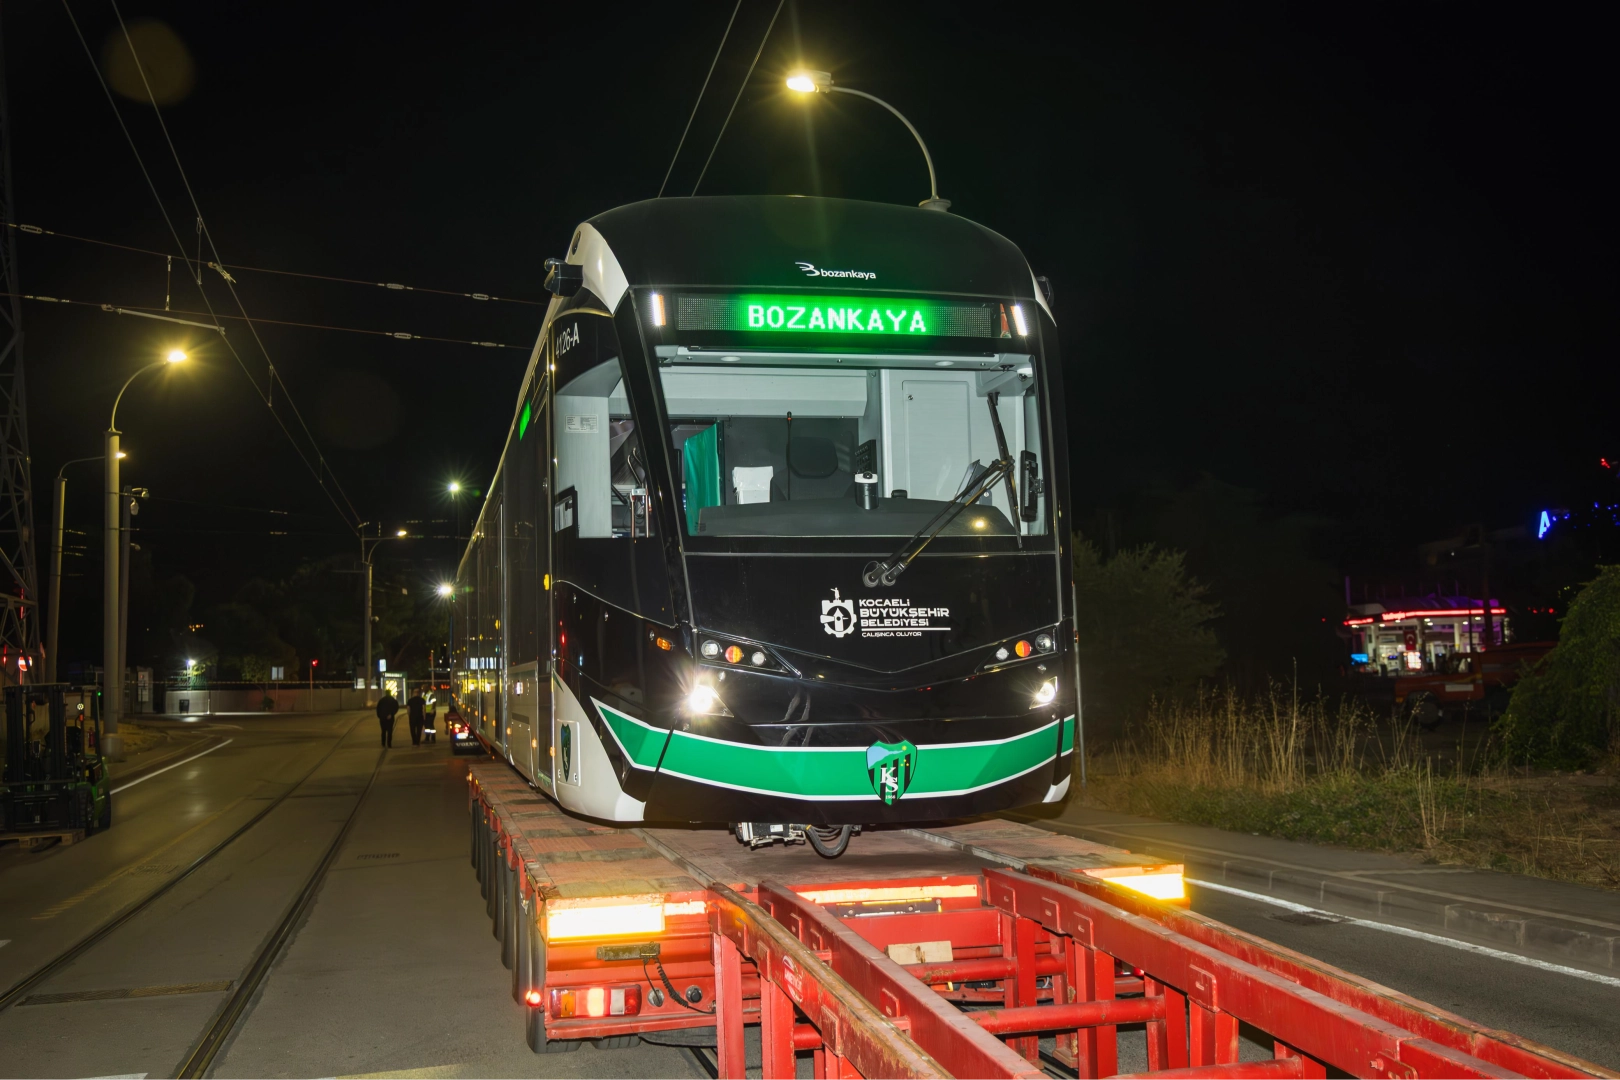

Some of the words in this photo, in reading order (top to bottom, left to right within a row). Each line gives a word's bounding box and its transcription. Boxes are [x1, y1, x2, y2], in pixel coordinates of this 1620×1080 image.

[820, 268, 877, 281] bozankaya
[748, 304, 926, 332] BOZANKAYA
[859, 598, 910, 607] KOCAELİ
[859, 607, 950, 619] BÜYÜKŞEHİR
[860, 618, 929, 627] BELEDİYESİ
